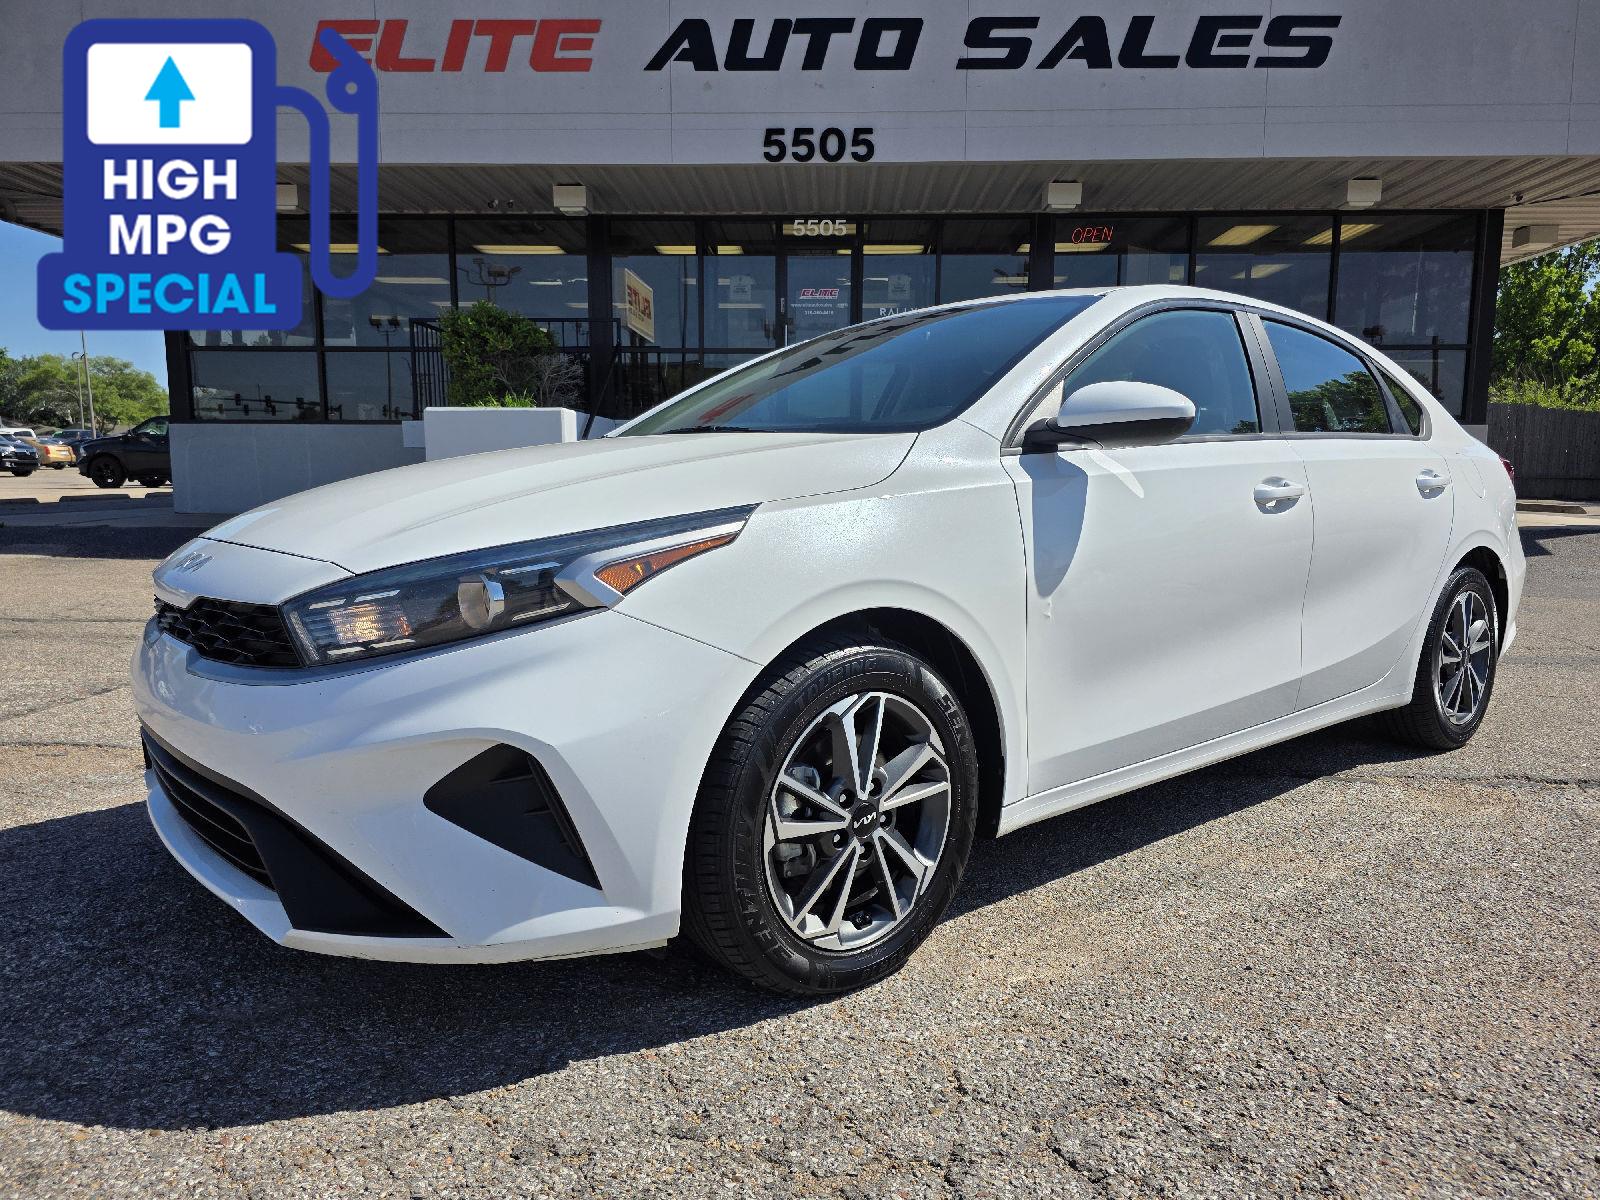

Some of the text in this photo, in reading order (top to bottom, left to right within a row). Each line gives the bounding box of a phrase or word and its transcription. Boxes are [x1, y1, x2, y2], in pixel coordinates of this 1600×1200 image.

[309, 15, 1343, 73] ELITE AUTO SALES
[763, 127, 875, 162] 5505
[793, 219, 847, 237] 5505
[1071, 226, 1114, 244] OPEN
[800, 288, 840, 297] ELITE
